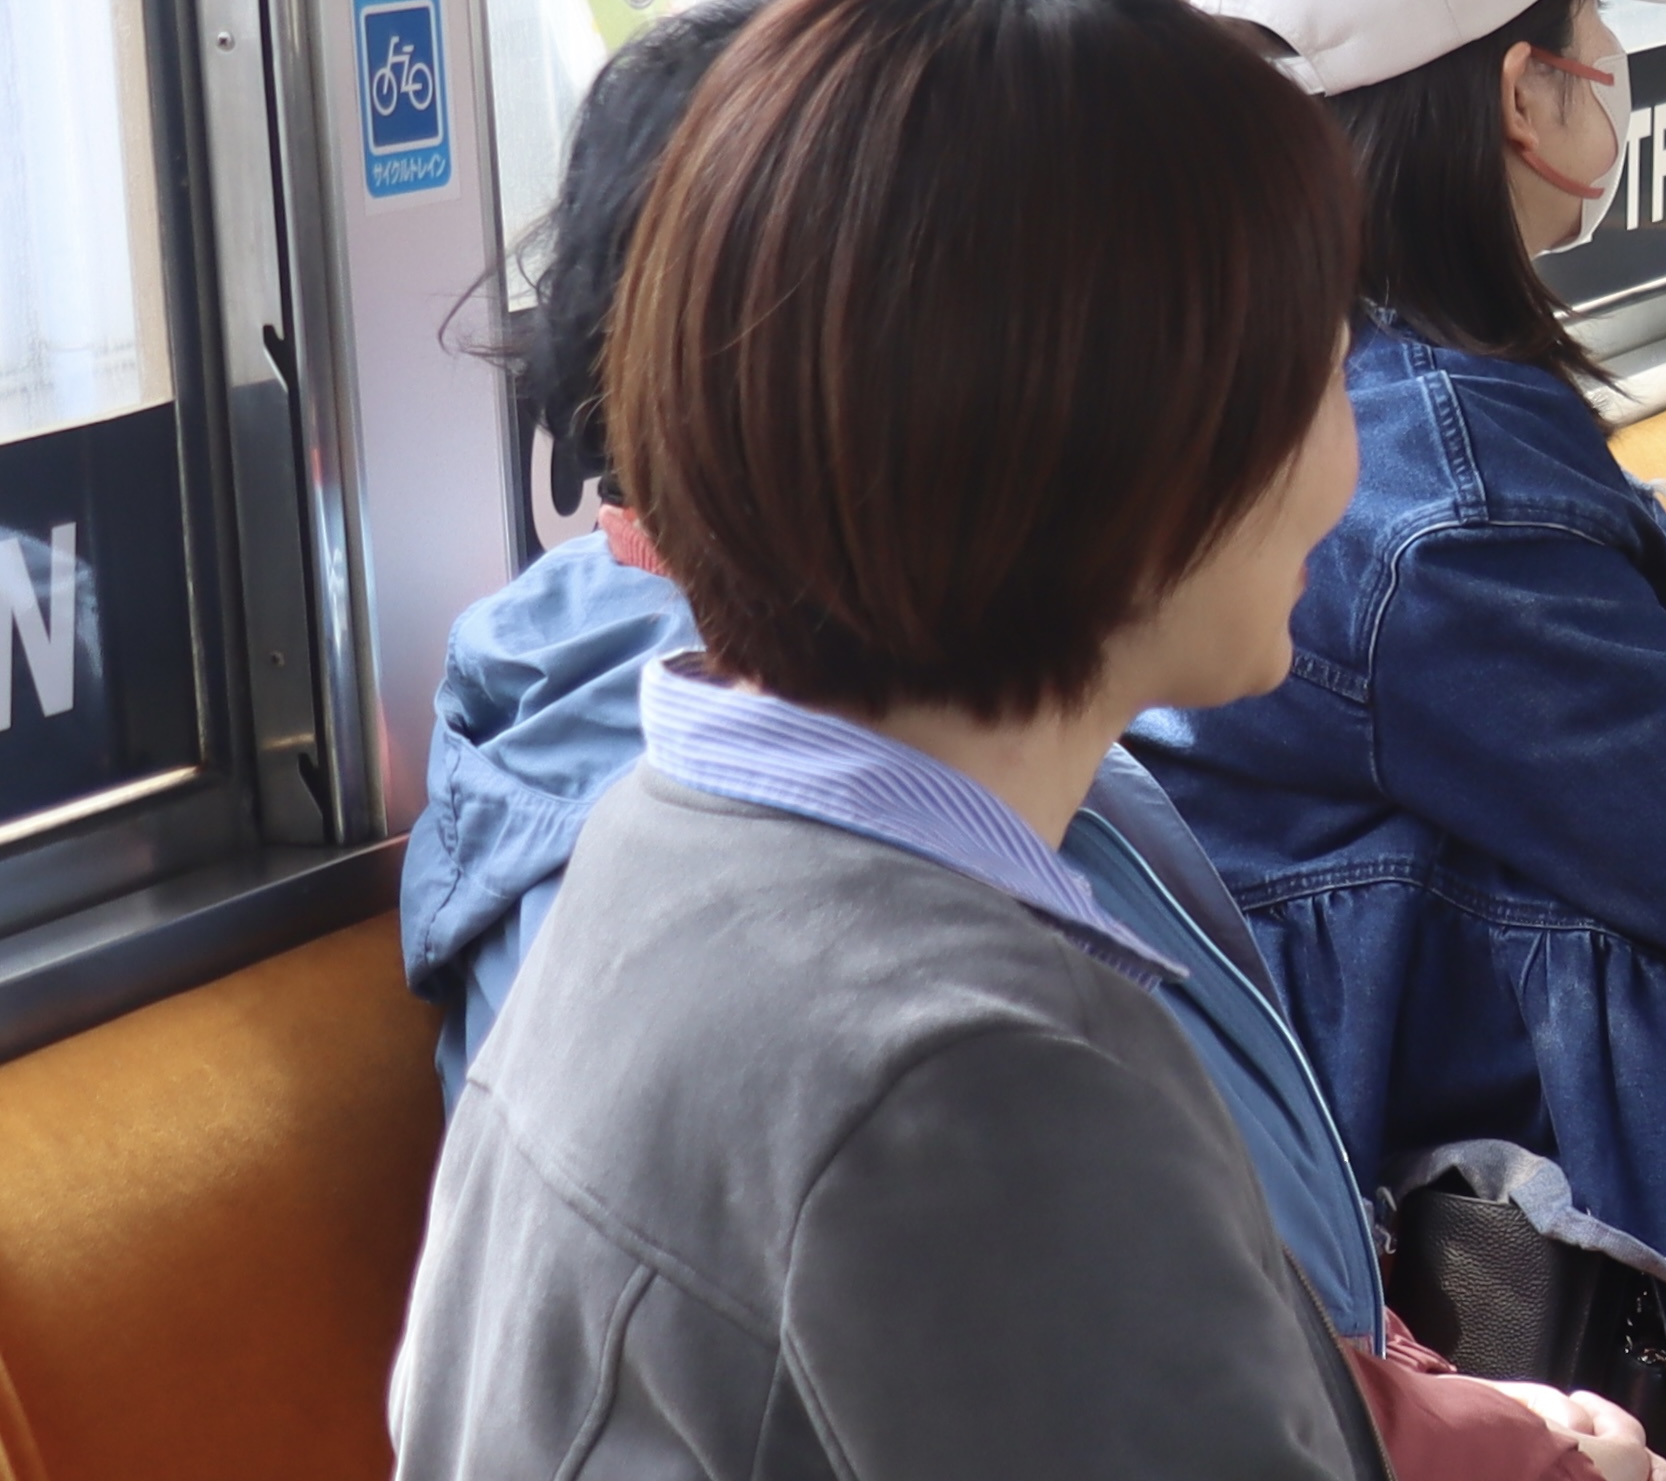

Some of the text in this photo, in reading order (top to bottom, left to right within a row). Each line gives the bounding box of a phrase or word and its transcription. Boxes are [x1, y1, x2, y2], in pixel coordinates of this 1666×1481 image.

[372, 152, 448, 189] サイクルトレイン
